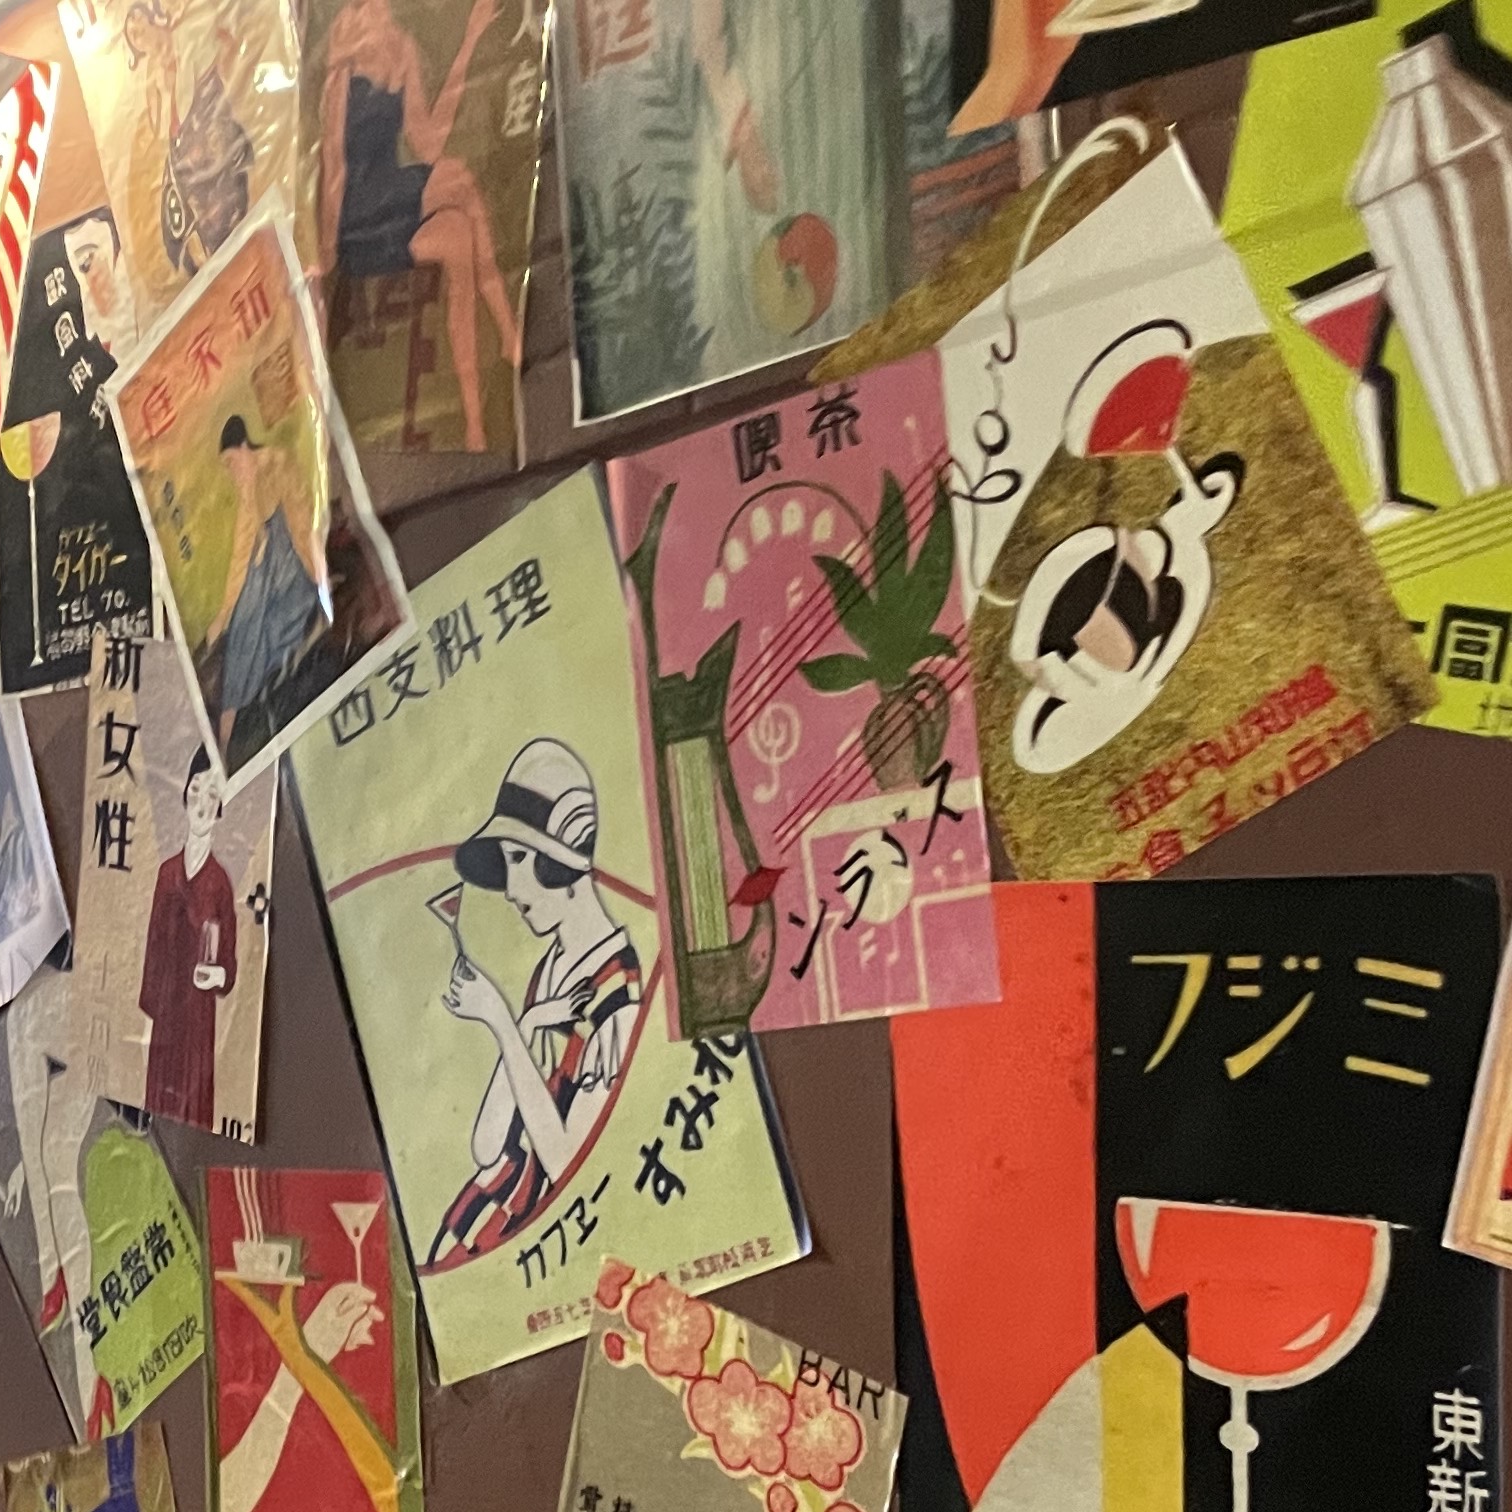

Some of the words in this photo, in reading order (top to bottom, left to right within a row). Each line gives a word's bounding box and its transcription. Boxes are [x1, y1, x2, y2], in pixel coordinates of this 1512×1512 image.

[94, 637, 145, 875] 新女性
[1131, 952, 1444, 1087] フジミ
[799, 1348, 886, 1420] BAR
